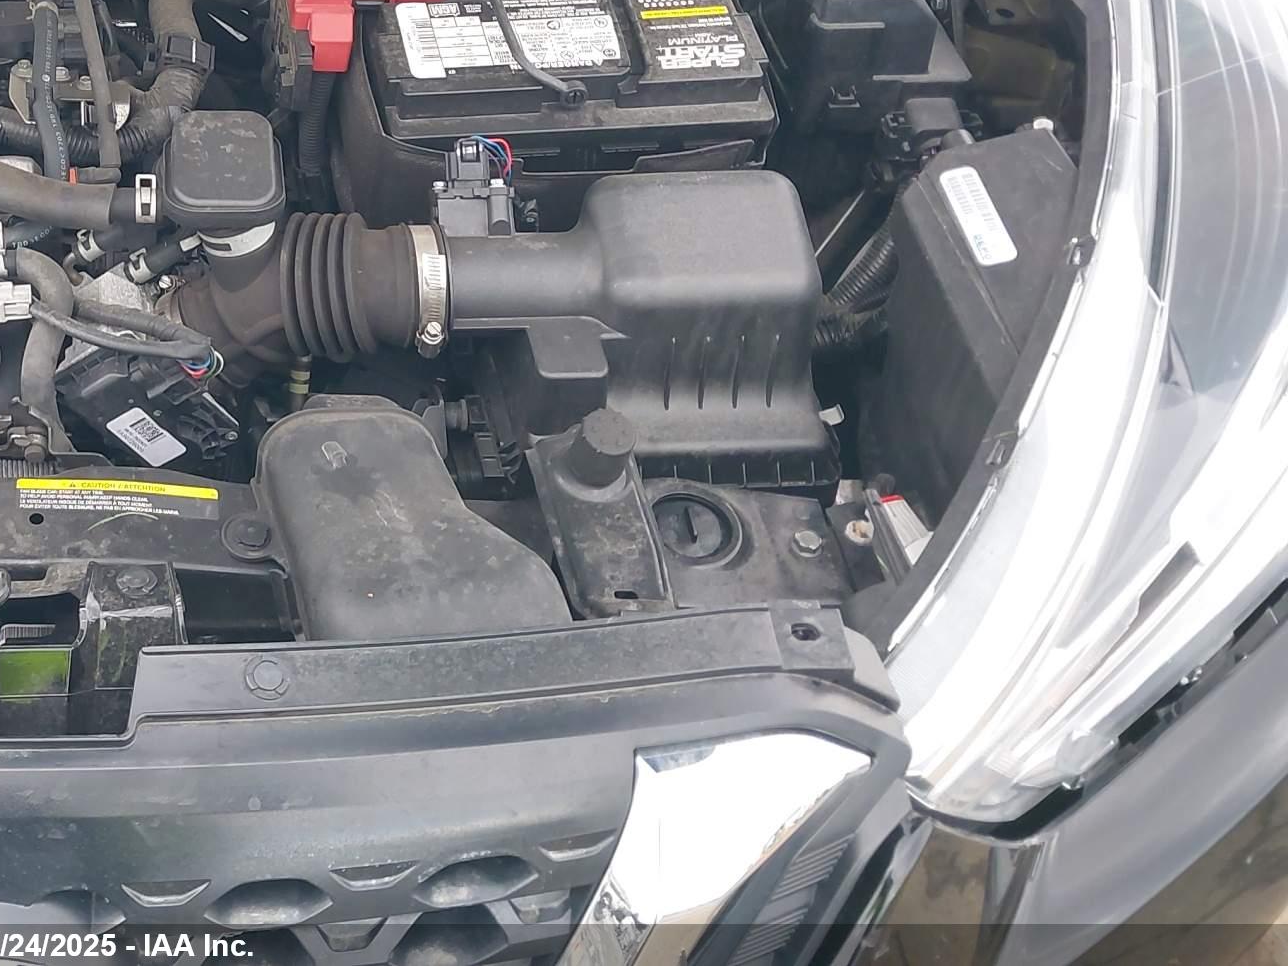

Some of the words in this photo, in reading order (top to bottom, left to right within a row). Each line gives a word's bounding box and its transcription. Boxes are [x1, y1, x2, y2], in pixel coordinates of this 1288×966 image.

[668, 34, 739, 46] PLATINUM
[658, 43, 746, 59] START
[656, 55, 741, 70] SUPER
